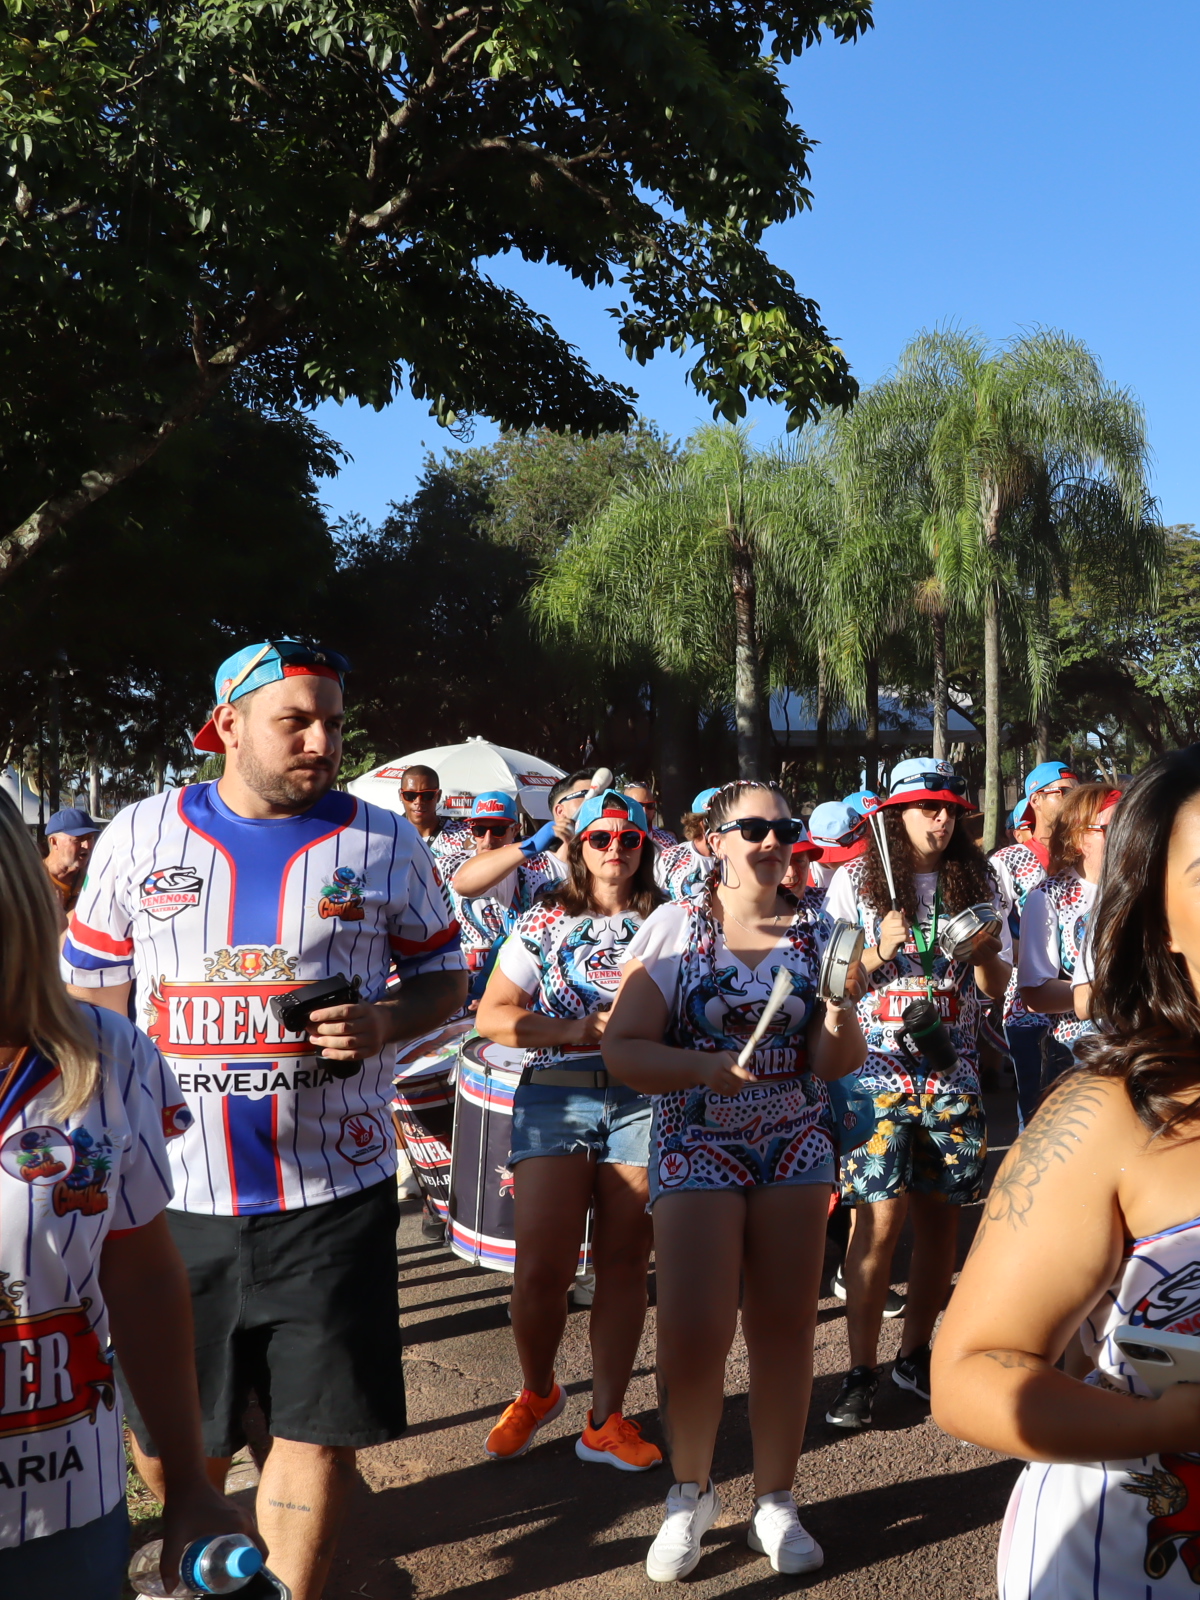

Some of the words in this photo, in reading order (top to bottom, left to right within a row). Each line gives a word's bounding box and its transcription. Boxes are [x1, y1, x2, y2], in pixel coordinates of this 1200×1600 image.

[141, 893, 197, 907] VENENOSA
[168, 995, 306, 1046] KREM
[178, 1070, 334, 1094] ERVEJARIA
[708, 1081, 801, 1106] CERVEJARIA
